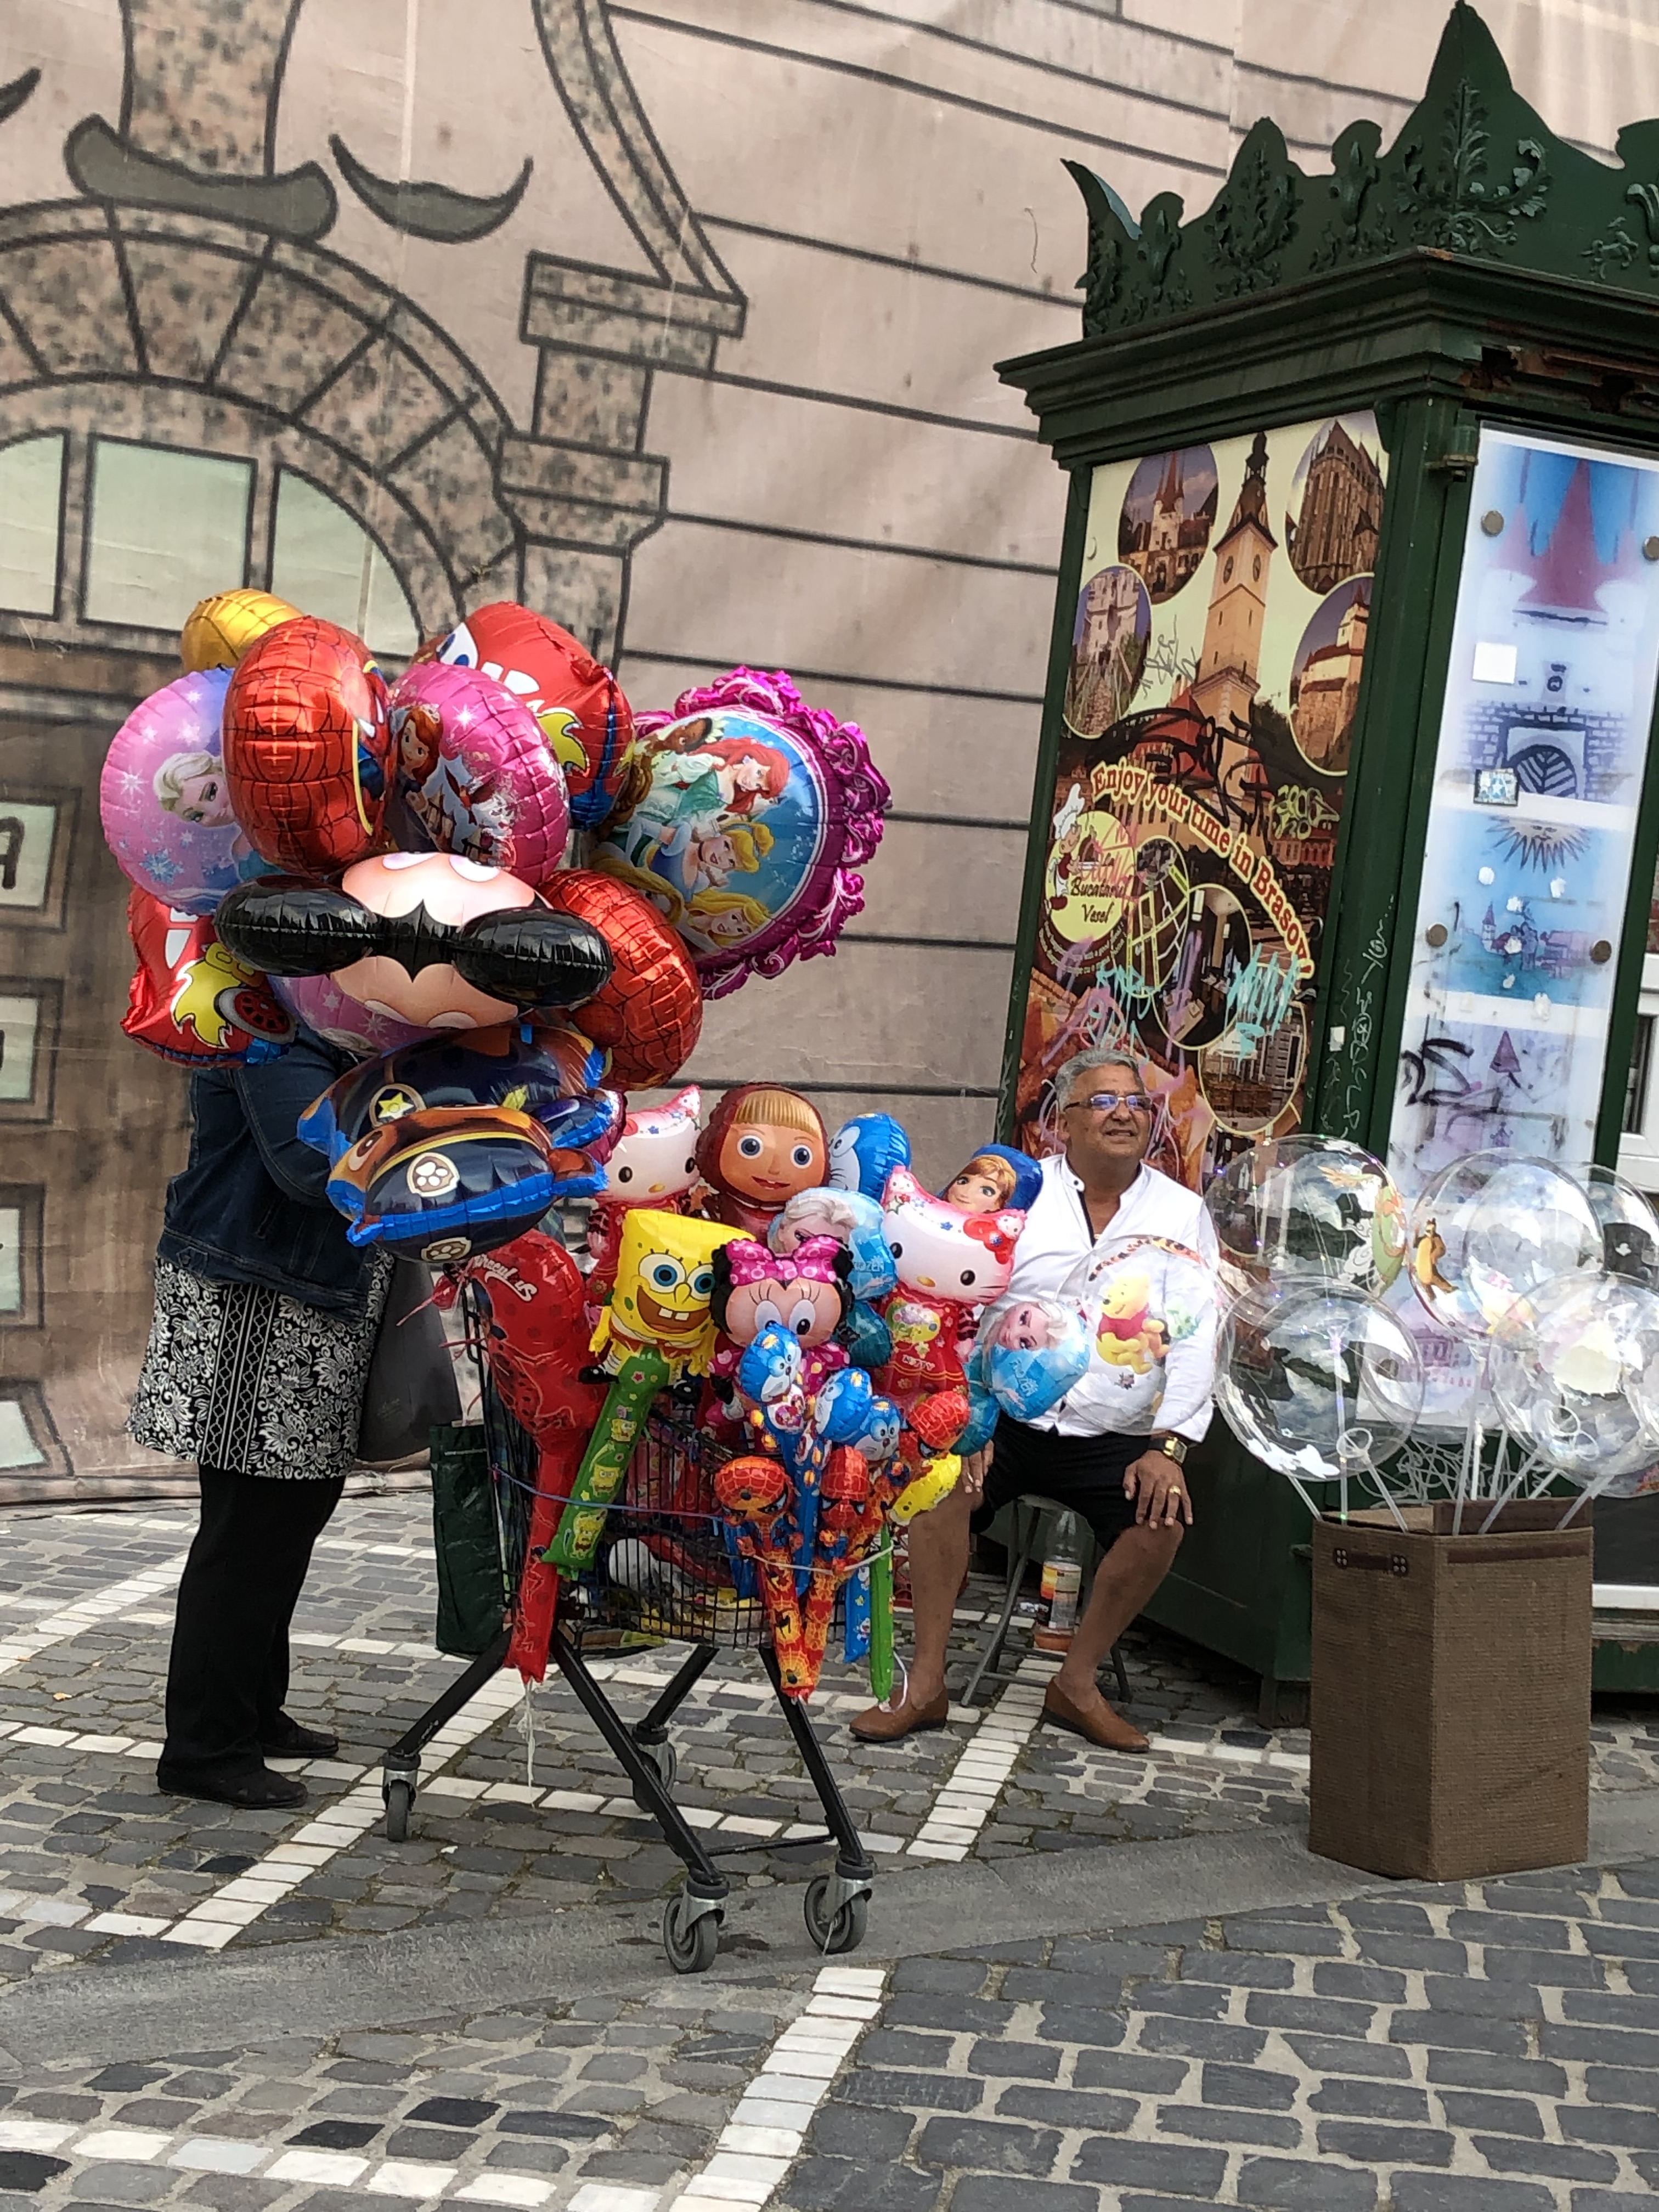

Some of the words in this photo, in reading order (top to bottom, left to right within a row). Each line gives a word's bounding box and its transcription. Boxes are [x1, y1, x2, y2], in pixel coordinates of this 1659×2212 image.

[1092, 759, 1146, 800] Enjoy
[1145, 775, 1189, 818] your
[1192, 800, 1232, 853] time
[1231, 836, 1255, 879] in
[1081, 901, 1115, 923] Vesel
